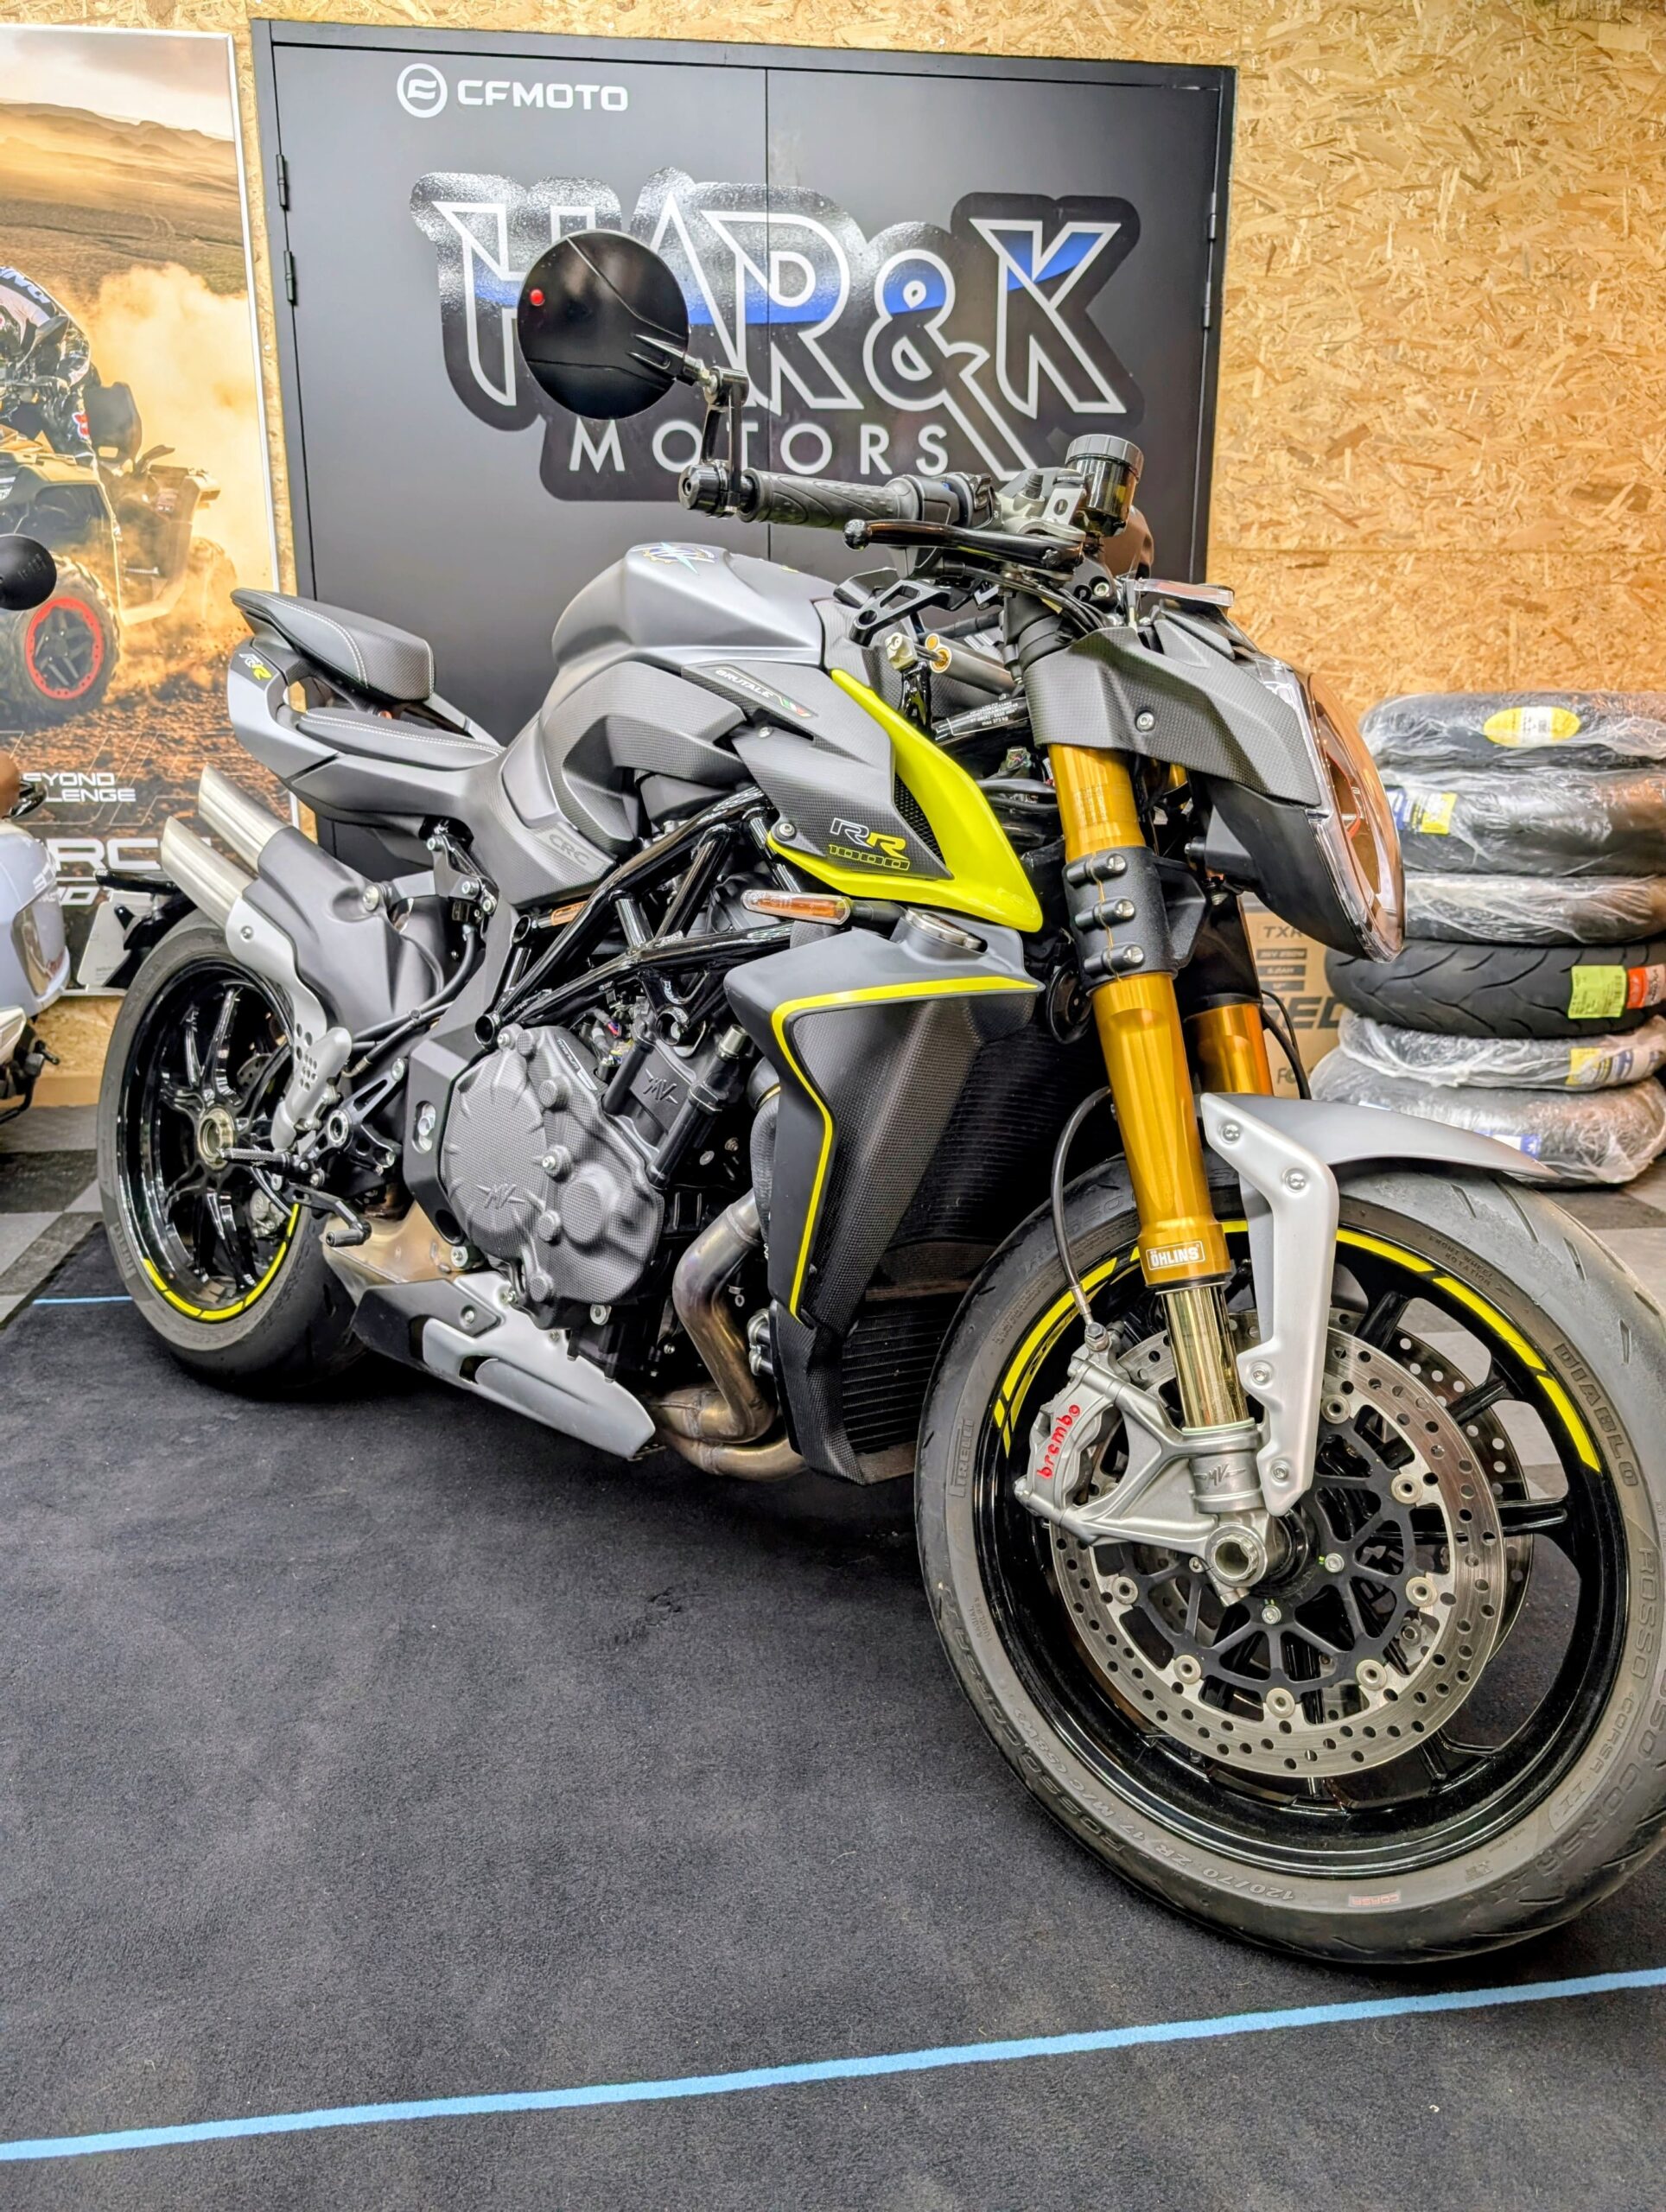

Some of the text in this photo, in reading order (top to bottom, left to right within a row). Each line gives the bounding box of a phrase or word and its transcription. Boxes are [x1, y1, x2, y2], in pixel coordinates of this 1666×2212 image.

[456, 79, 628, 112] CFMOTO
[715, 669, 774, 698] BRUTALE
[549, 833, 590, 866] CRC
[829, 843, 911, 871] 1000
[830, 817, 910, 861] RR
[643, 1069, 678, 1104] MV
[1150, 1247, 1199, 1268] ÖHLINS
[1553, 1343, 1639, 1487] DIABLO
[950, 1417, 975, 1498] PIRELLI
[1037, 1403, 1081, 1480] brembo
[1631, 1547, 1659, 1680] ROSSO
[953, 1626, 1021, 1747] CORSA
[1589, 1696, 1635, 1775] CORSA
[1021, 1751, 1125, 1853] ROSSO
[1069, 1778, 1115, 1817] M/C
[1119, 1821, 1146, 1840] 17
[1154, 1843, 1192, 1867] ZR
[1202, 1867, 1295, 1901] 120/70
